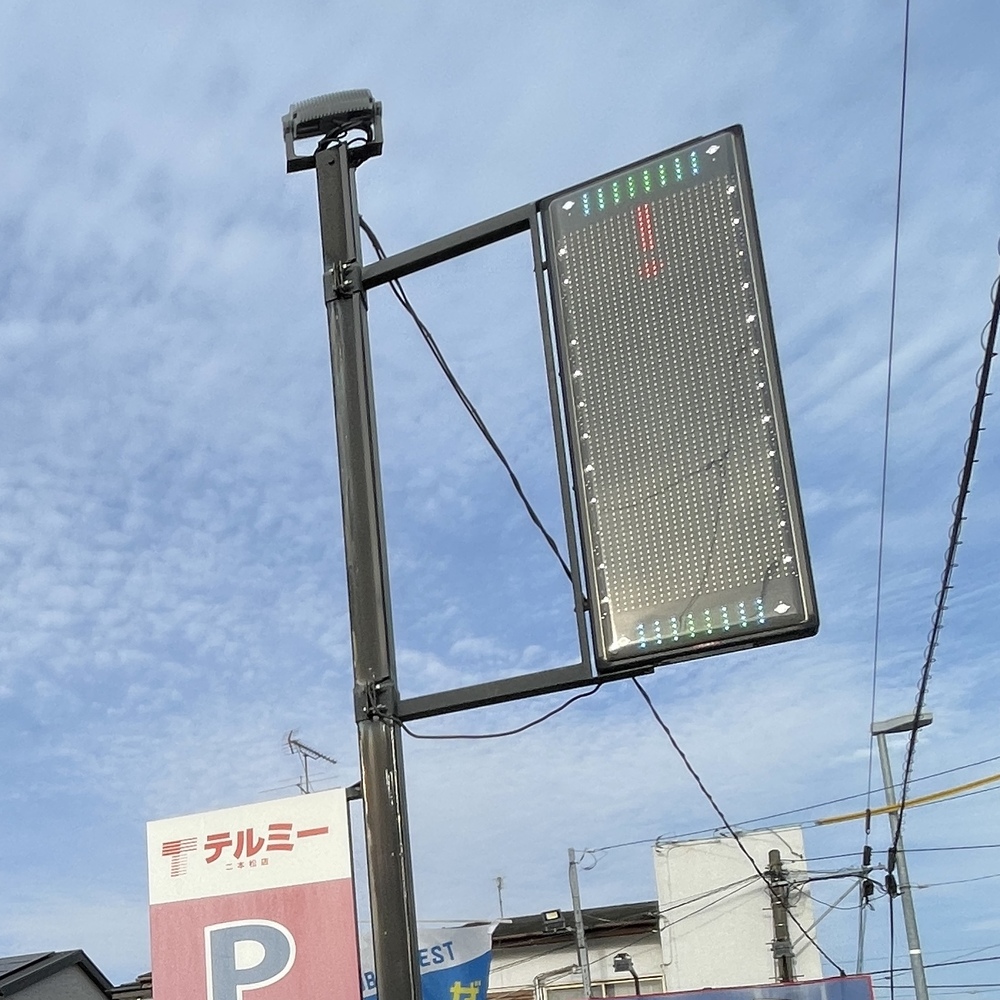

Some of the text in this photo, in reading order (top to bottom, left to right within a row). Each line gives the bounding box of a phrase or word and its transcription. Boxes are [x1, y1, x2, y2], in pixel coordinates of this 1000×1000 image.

[204, 823, 329, 864] テルミー
[226, 857, 269, 871] 二本松店
[418, 941, 454, 967] EST
